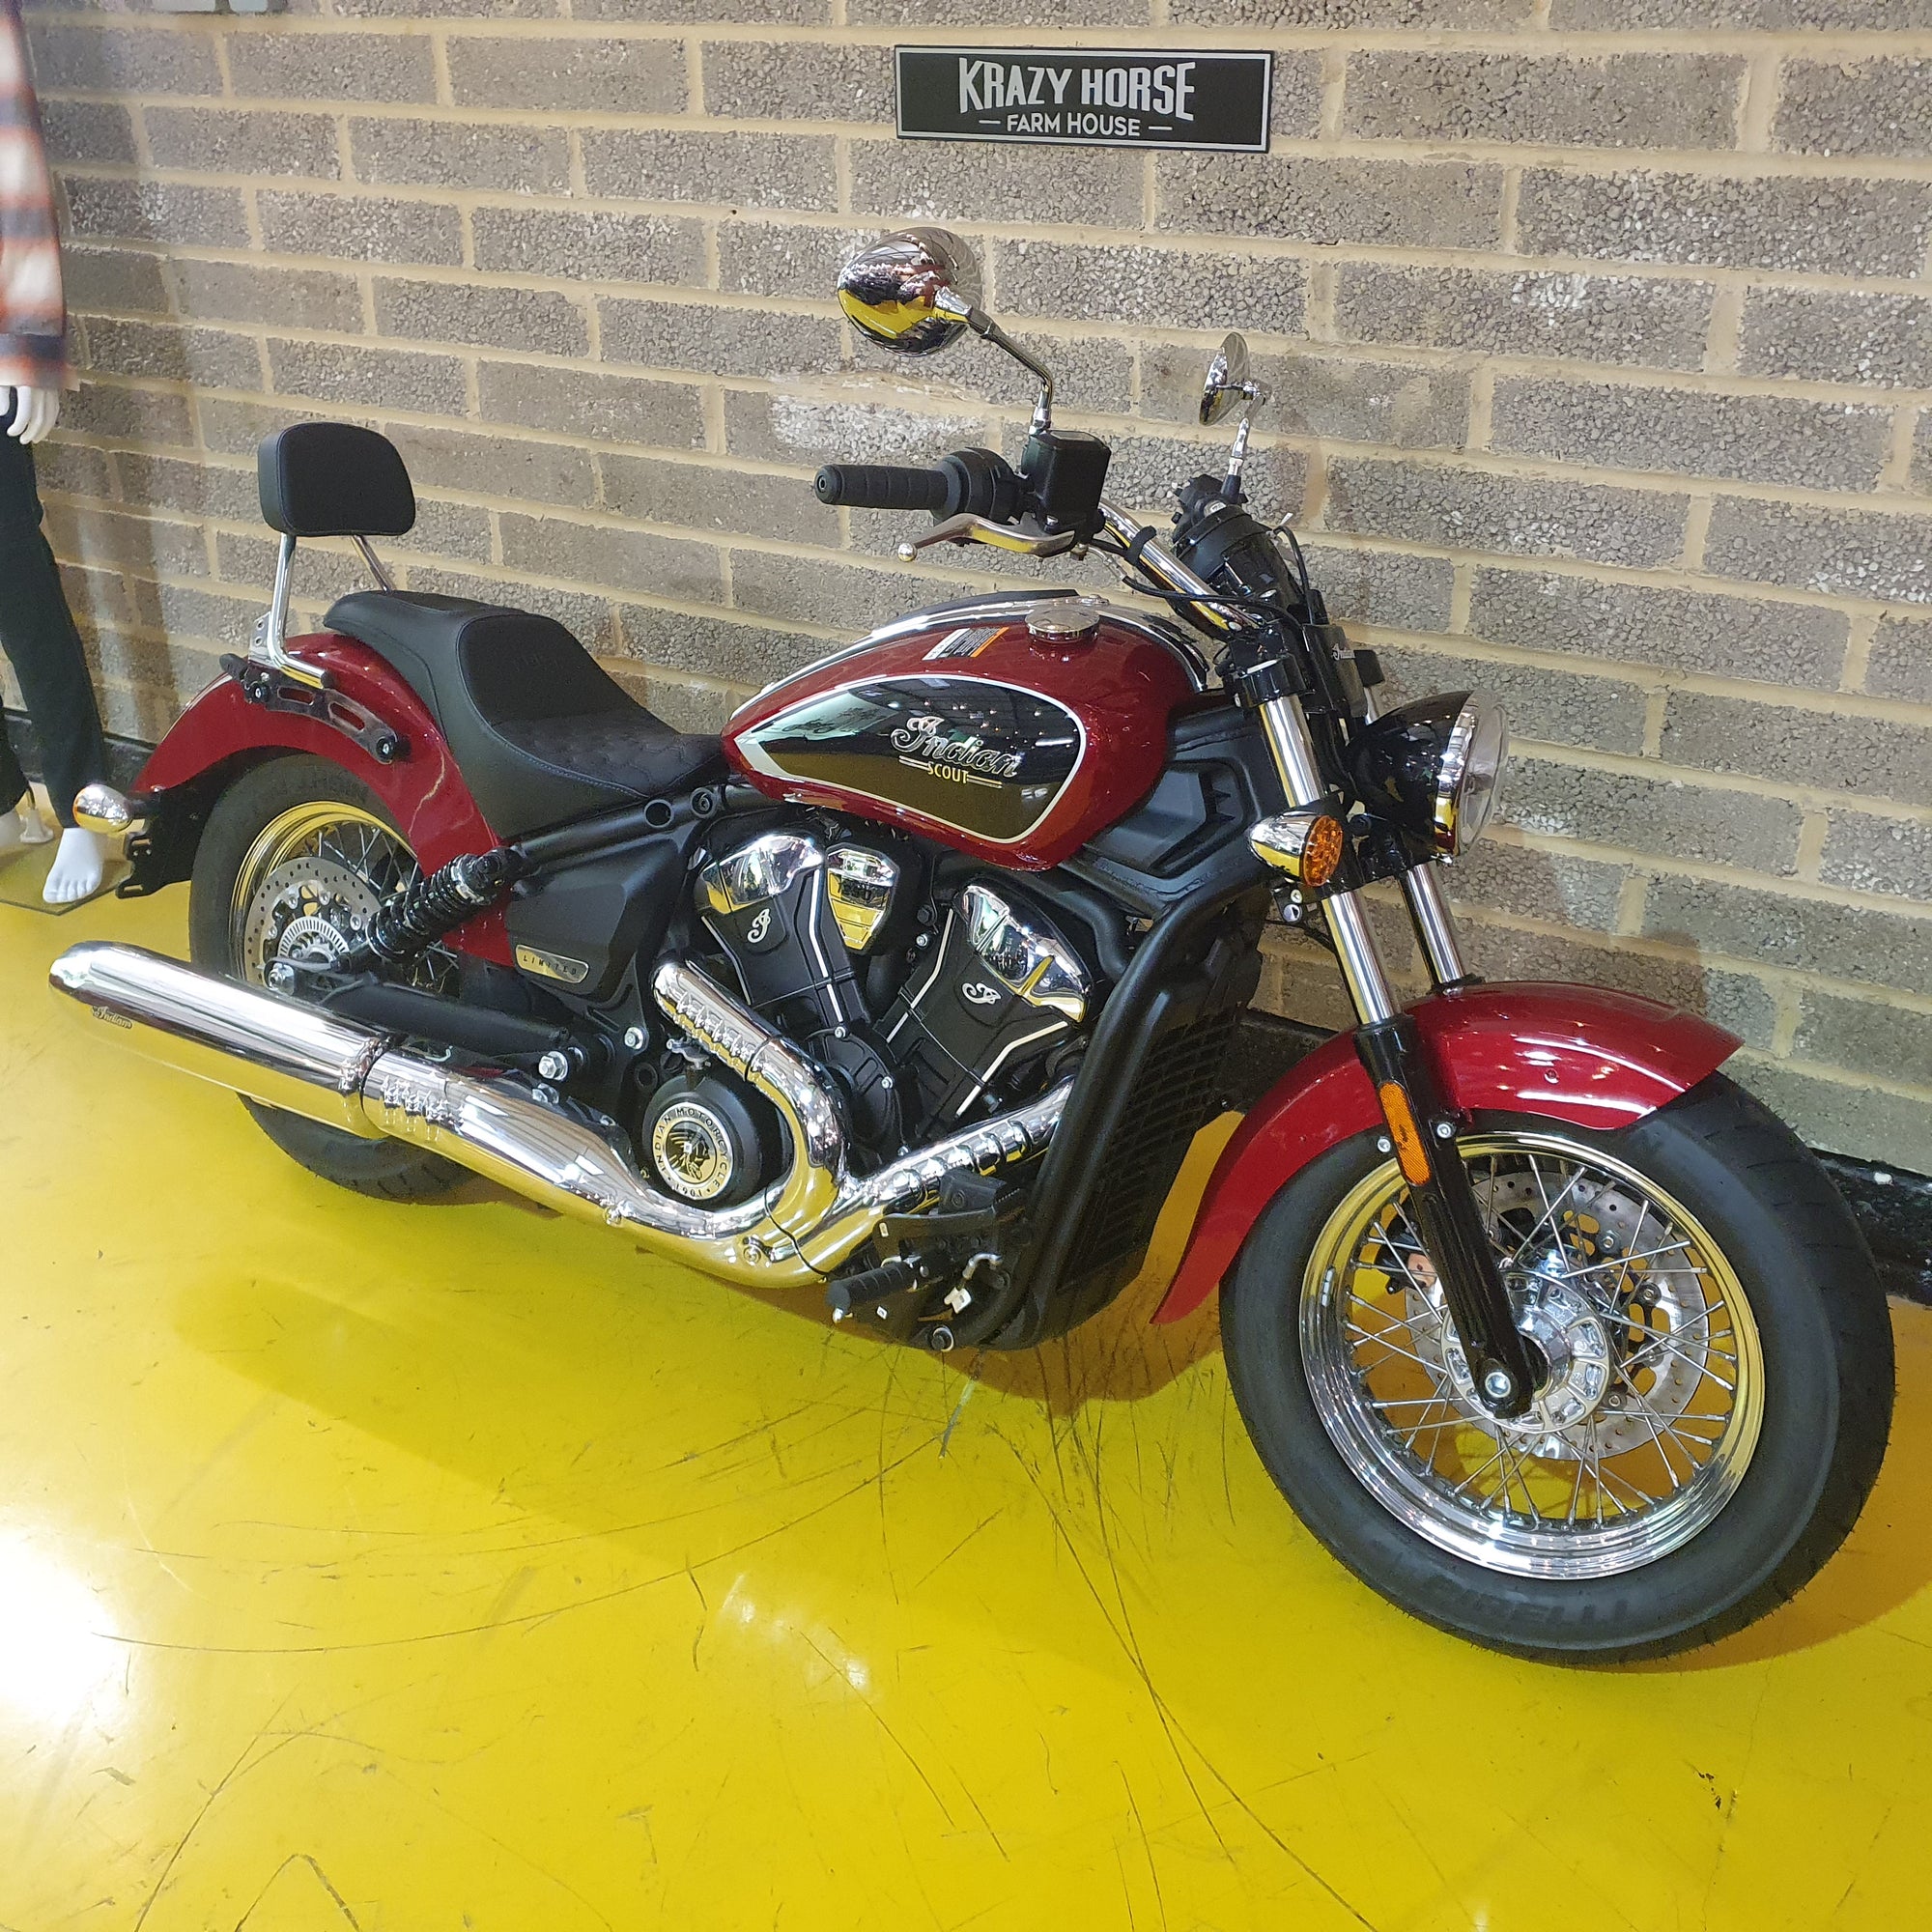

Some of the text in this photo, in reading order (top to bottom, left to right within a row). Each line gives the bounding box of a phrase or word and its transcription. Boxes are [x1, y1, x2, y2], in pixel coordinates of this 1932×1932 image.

[958, 56, 1196, 122] KRAZY HORSE
[1007, 111, 1141, 137] FARM HOUSE
[890, 715, 1019, 779] Indian
[927, 760, 969, 784] SCOUT
[654, 1107, 728, 1188] INDIAN MOTORCYCLE
